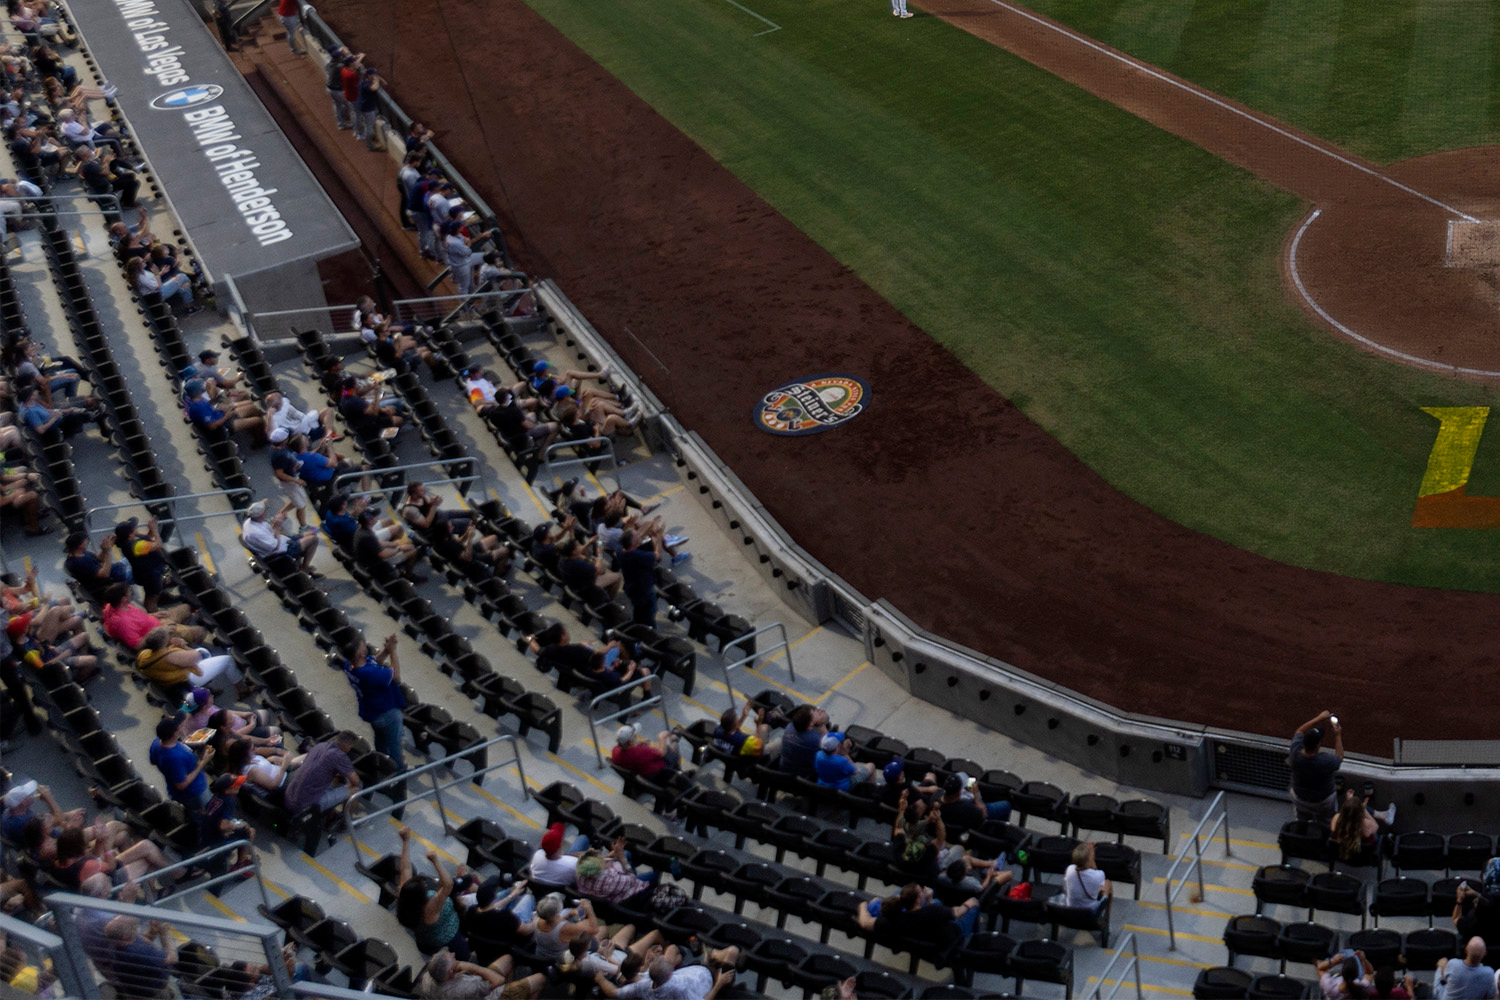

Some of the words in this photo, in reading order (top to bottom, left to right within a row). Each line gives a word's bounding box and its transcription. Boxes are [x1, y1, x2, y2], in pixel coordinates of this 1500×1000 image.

[128, 17, 169, 34] of
[143, 45, 191, 87] Vegas
[184, 104, 242, 146] BMW
[205, 143, 254, 163] of
[215, 155, 294, 248] Henderson
[790, 385, 839, 424] Steiner's
